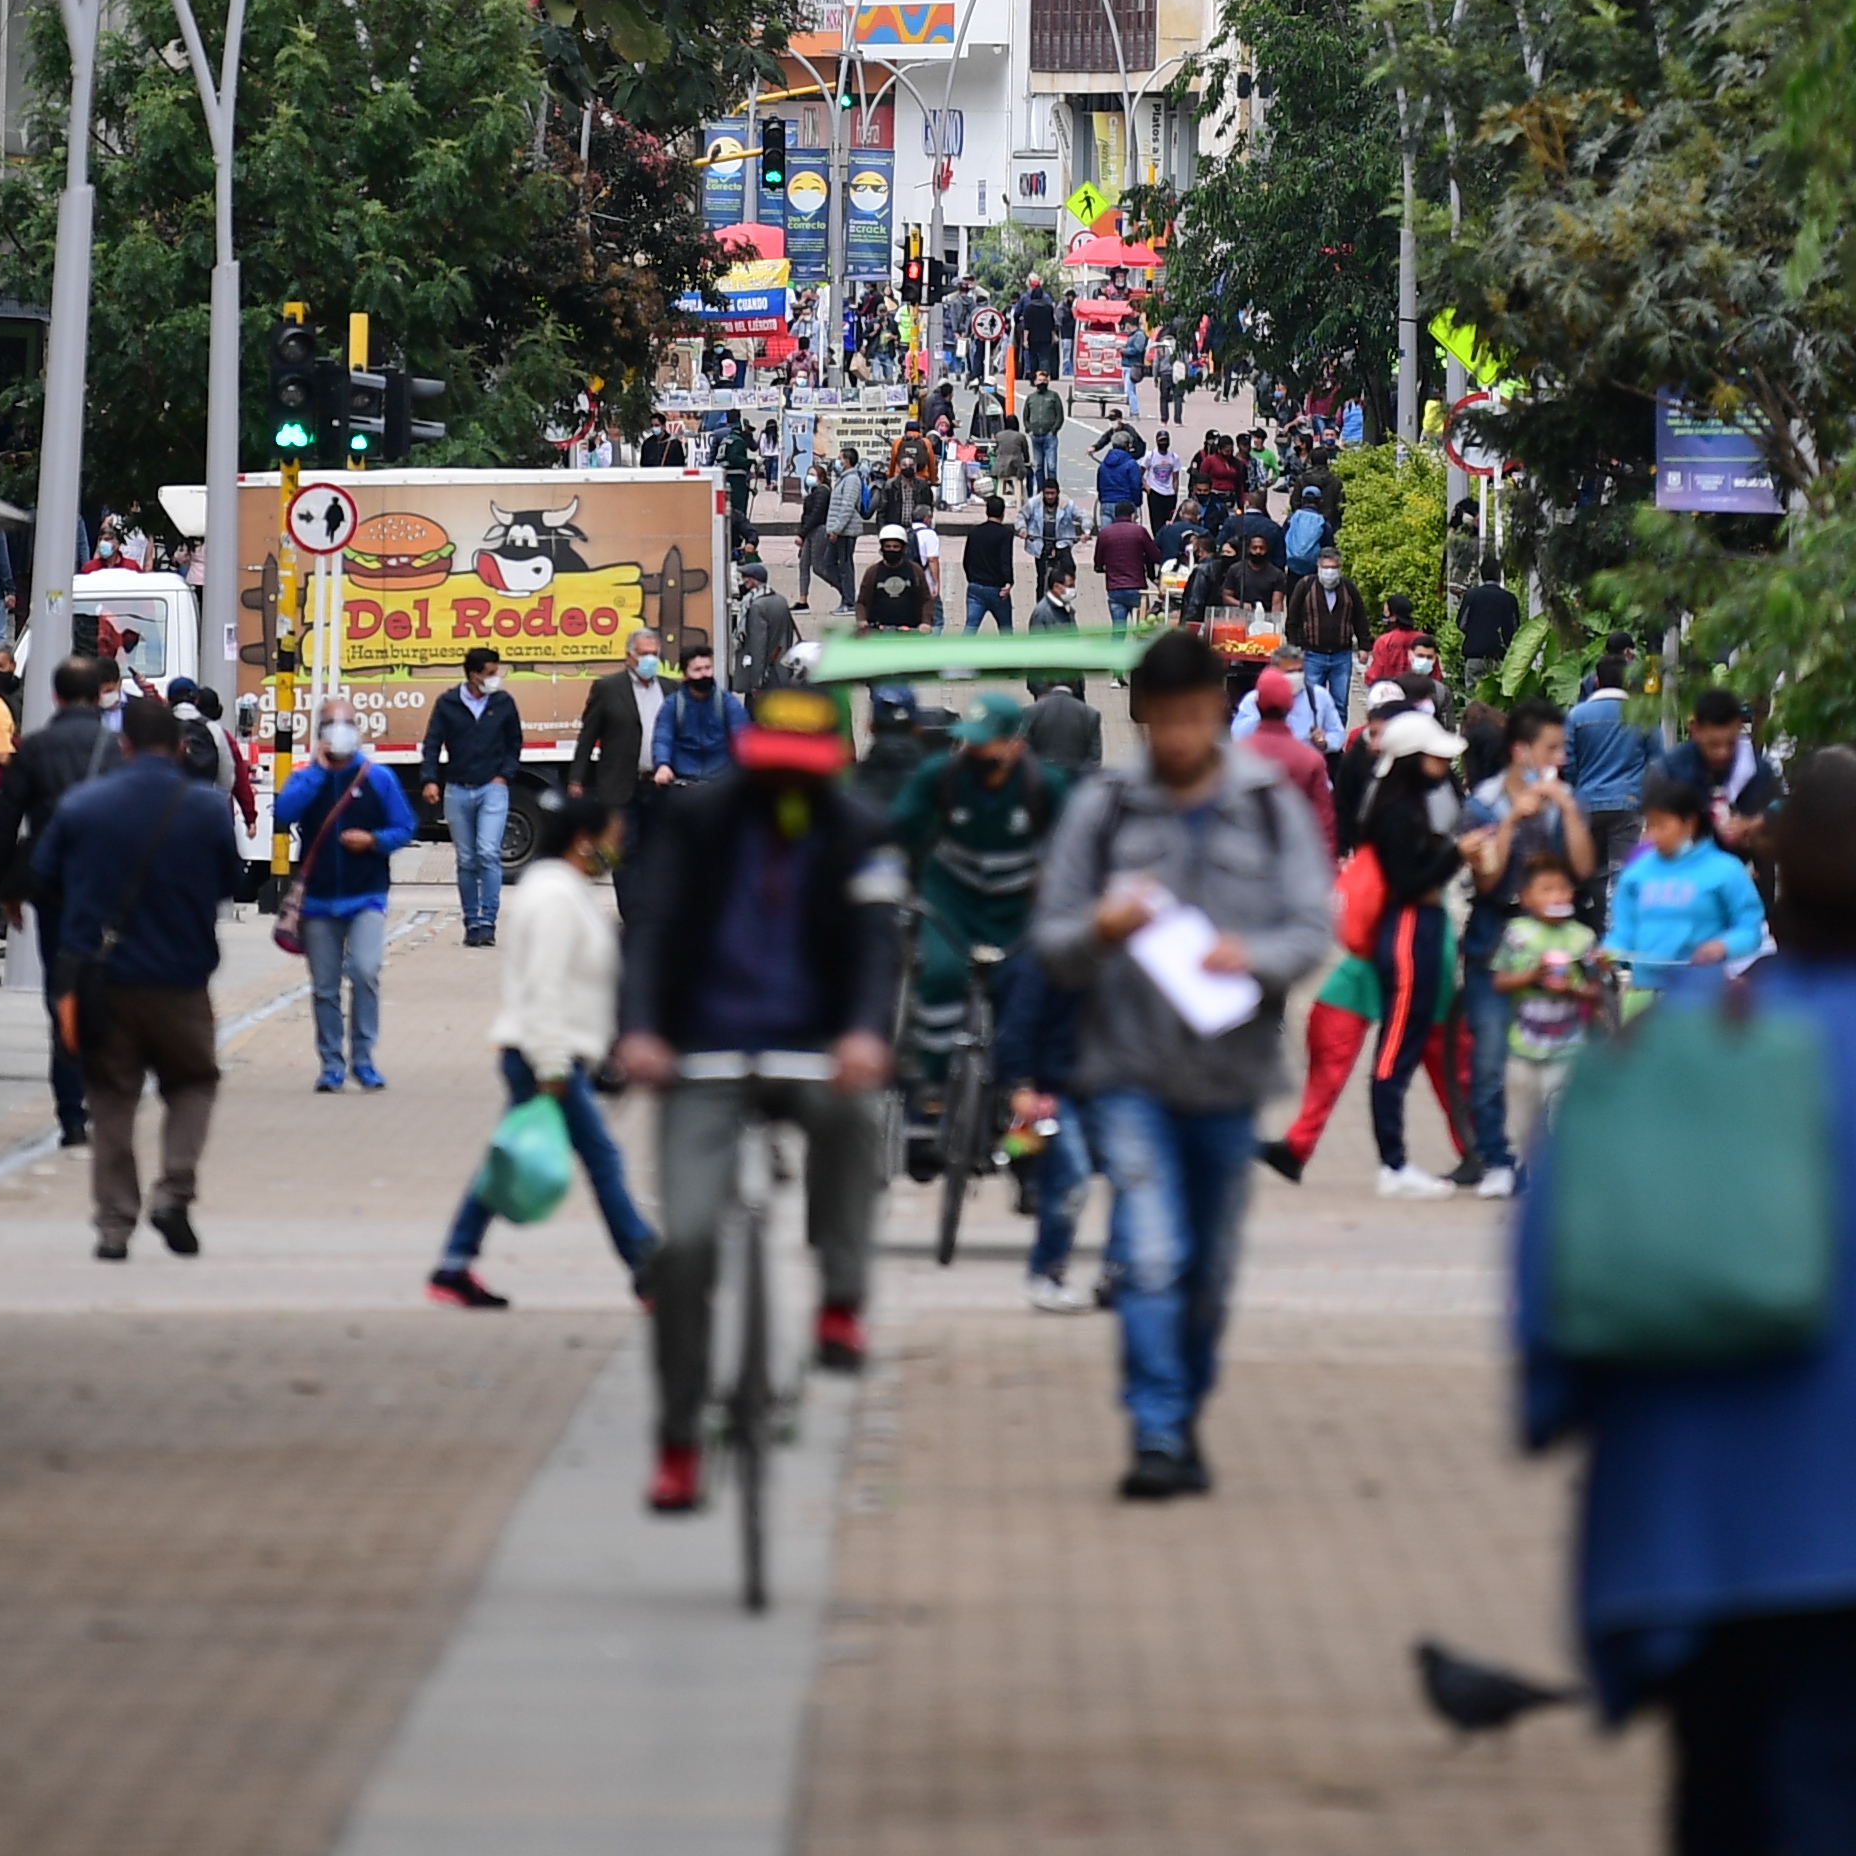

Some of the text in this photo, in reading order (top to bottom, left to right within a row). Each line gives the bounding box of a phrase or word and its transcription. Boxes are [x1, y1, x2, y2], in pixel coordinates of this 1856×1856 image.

[344, 595, 619, 640] Del Rodeo
[506, 645, 556, 658] carne,
[562, 640, 614, 656] carne!
